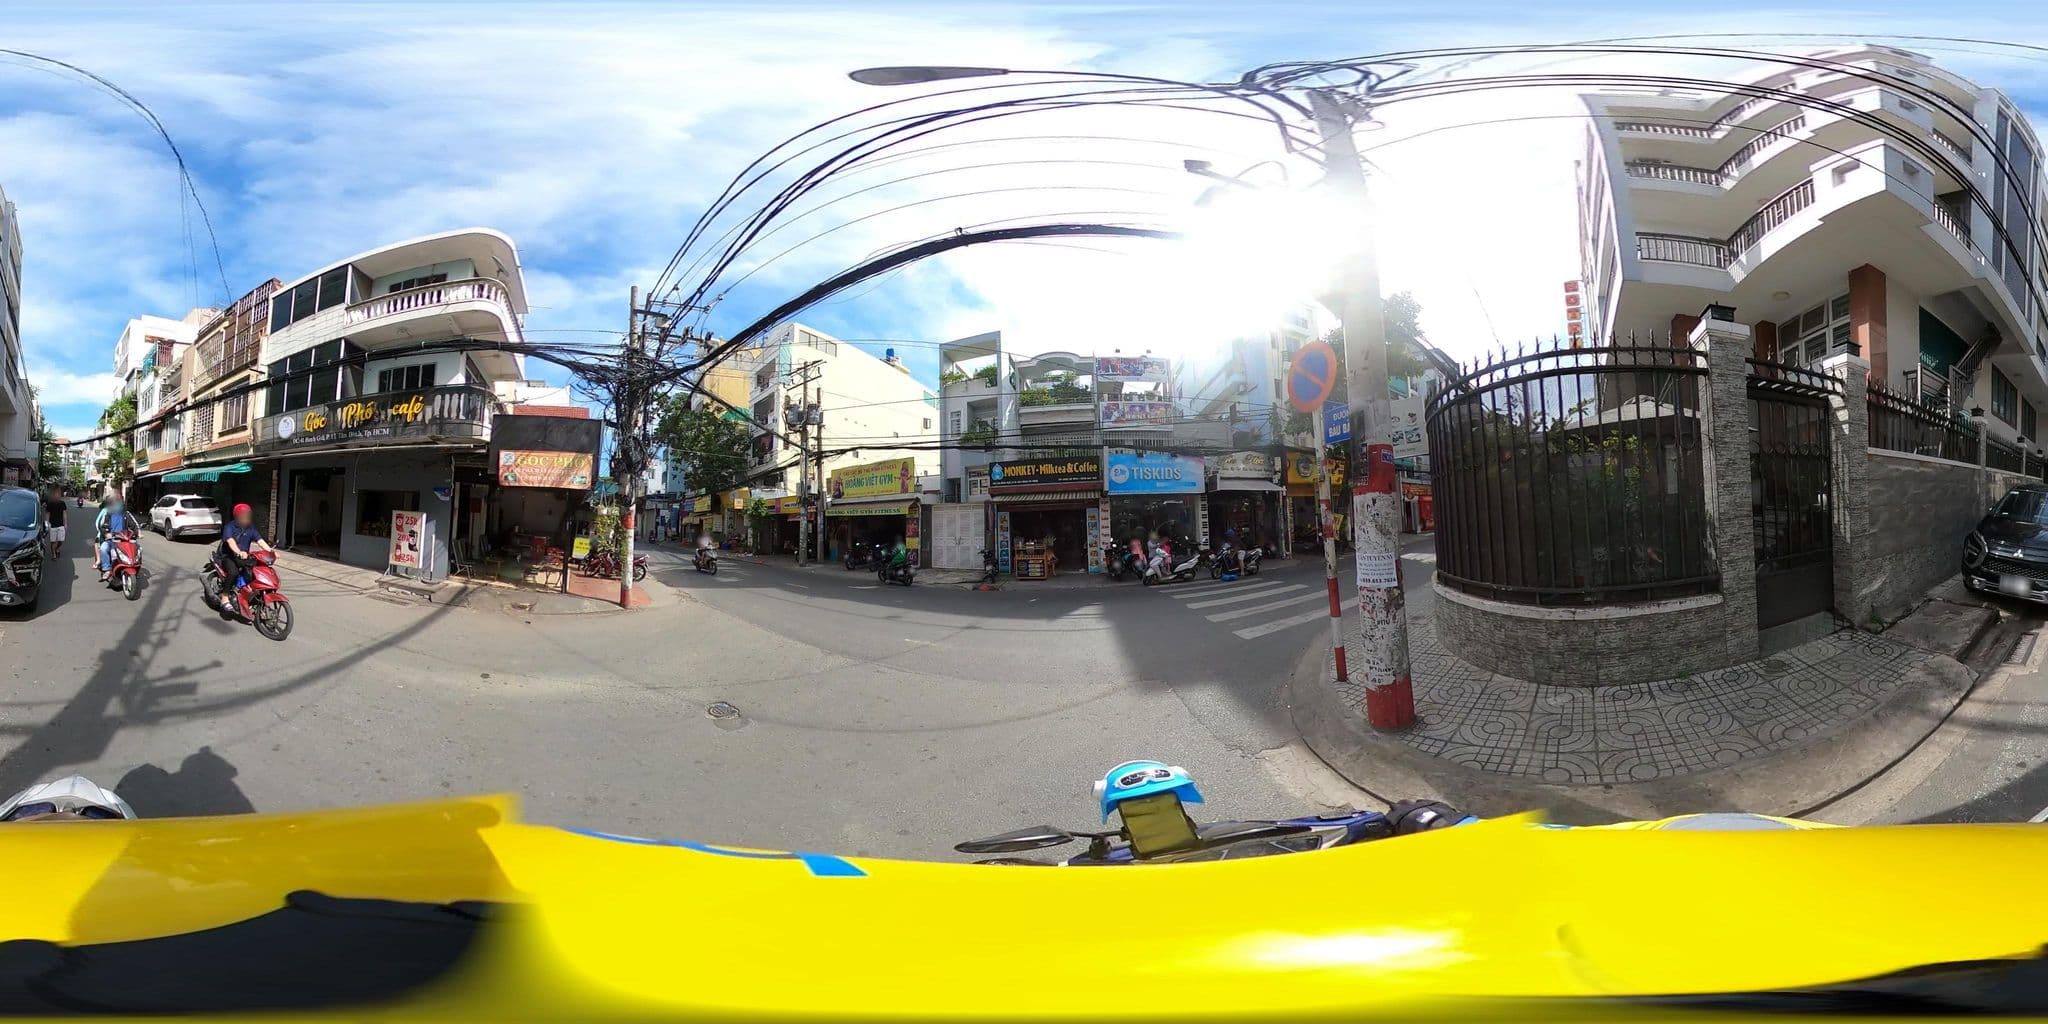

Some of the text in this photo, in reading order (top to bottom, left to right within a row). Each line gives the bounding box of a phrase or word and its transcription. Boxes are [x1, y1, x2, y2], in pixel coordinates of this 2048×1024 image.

[392, 394, 424, 423] café
[879, 473, 893, 486] GYM
[1131, 466, 1182, 480] TISKIDS
